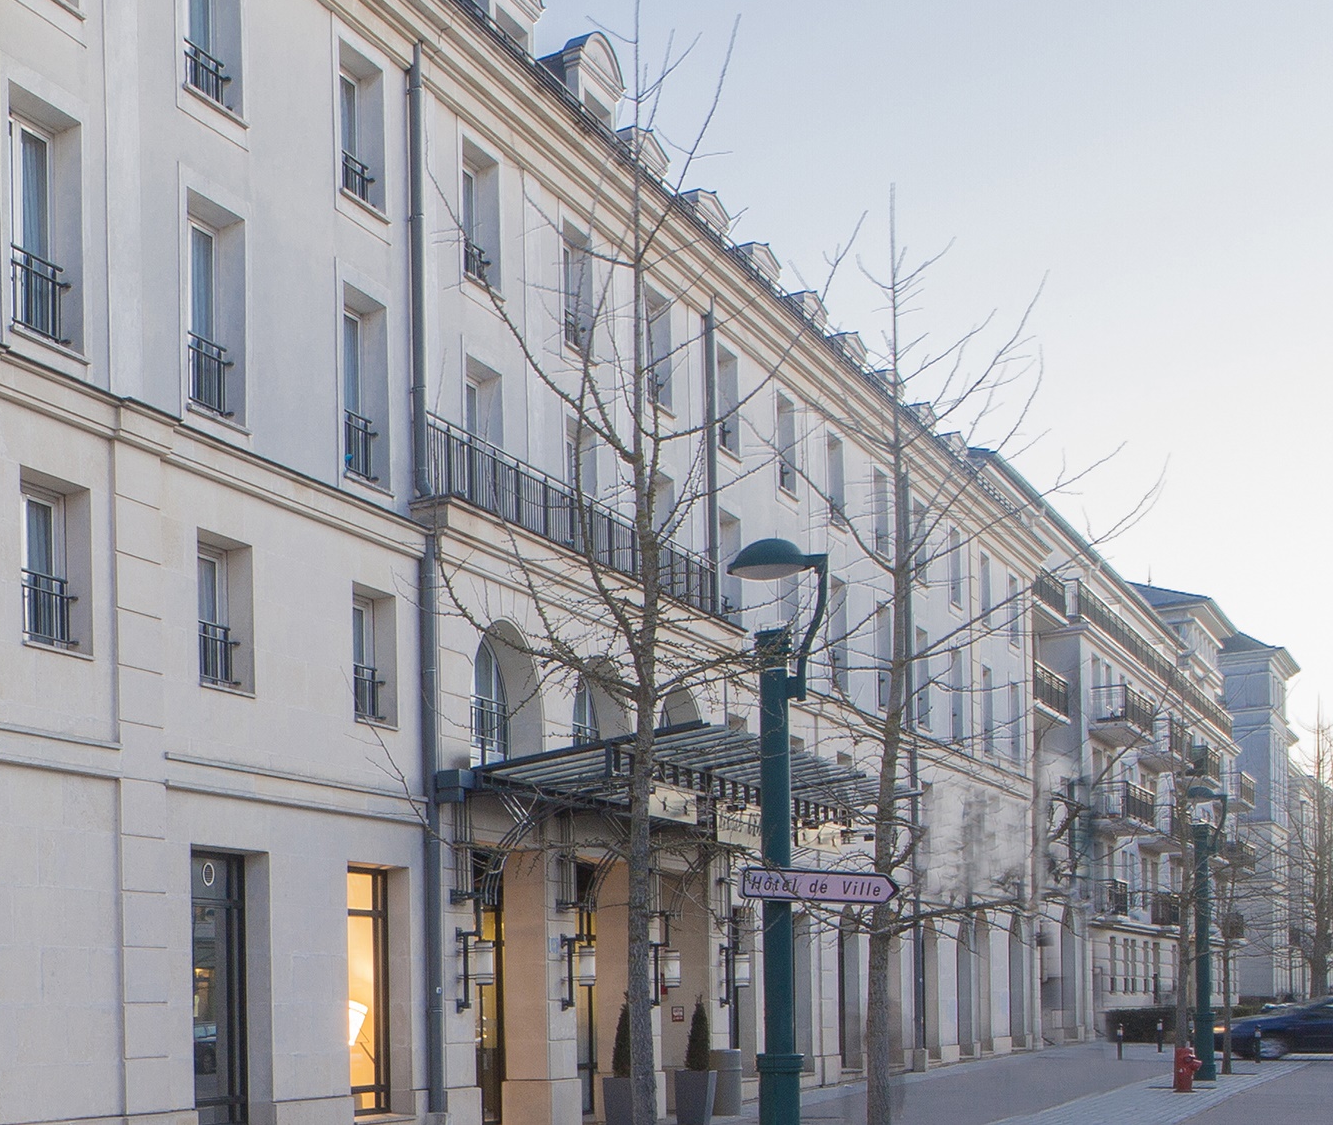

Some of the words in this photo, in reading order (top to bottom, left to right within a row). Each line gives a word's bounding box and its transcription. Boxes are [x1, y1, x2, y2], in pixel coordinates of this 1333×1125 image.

[750, 875, 798, 893] Hôtel
[808, 879, 828, 894] de
[842, 880, 882, 897] Ville
